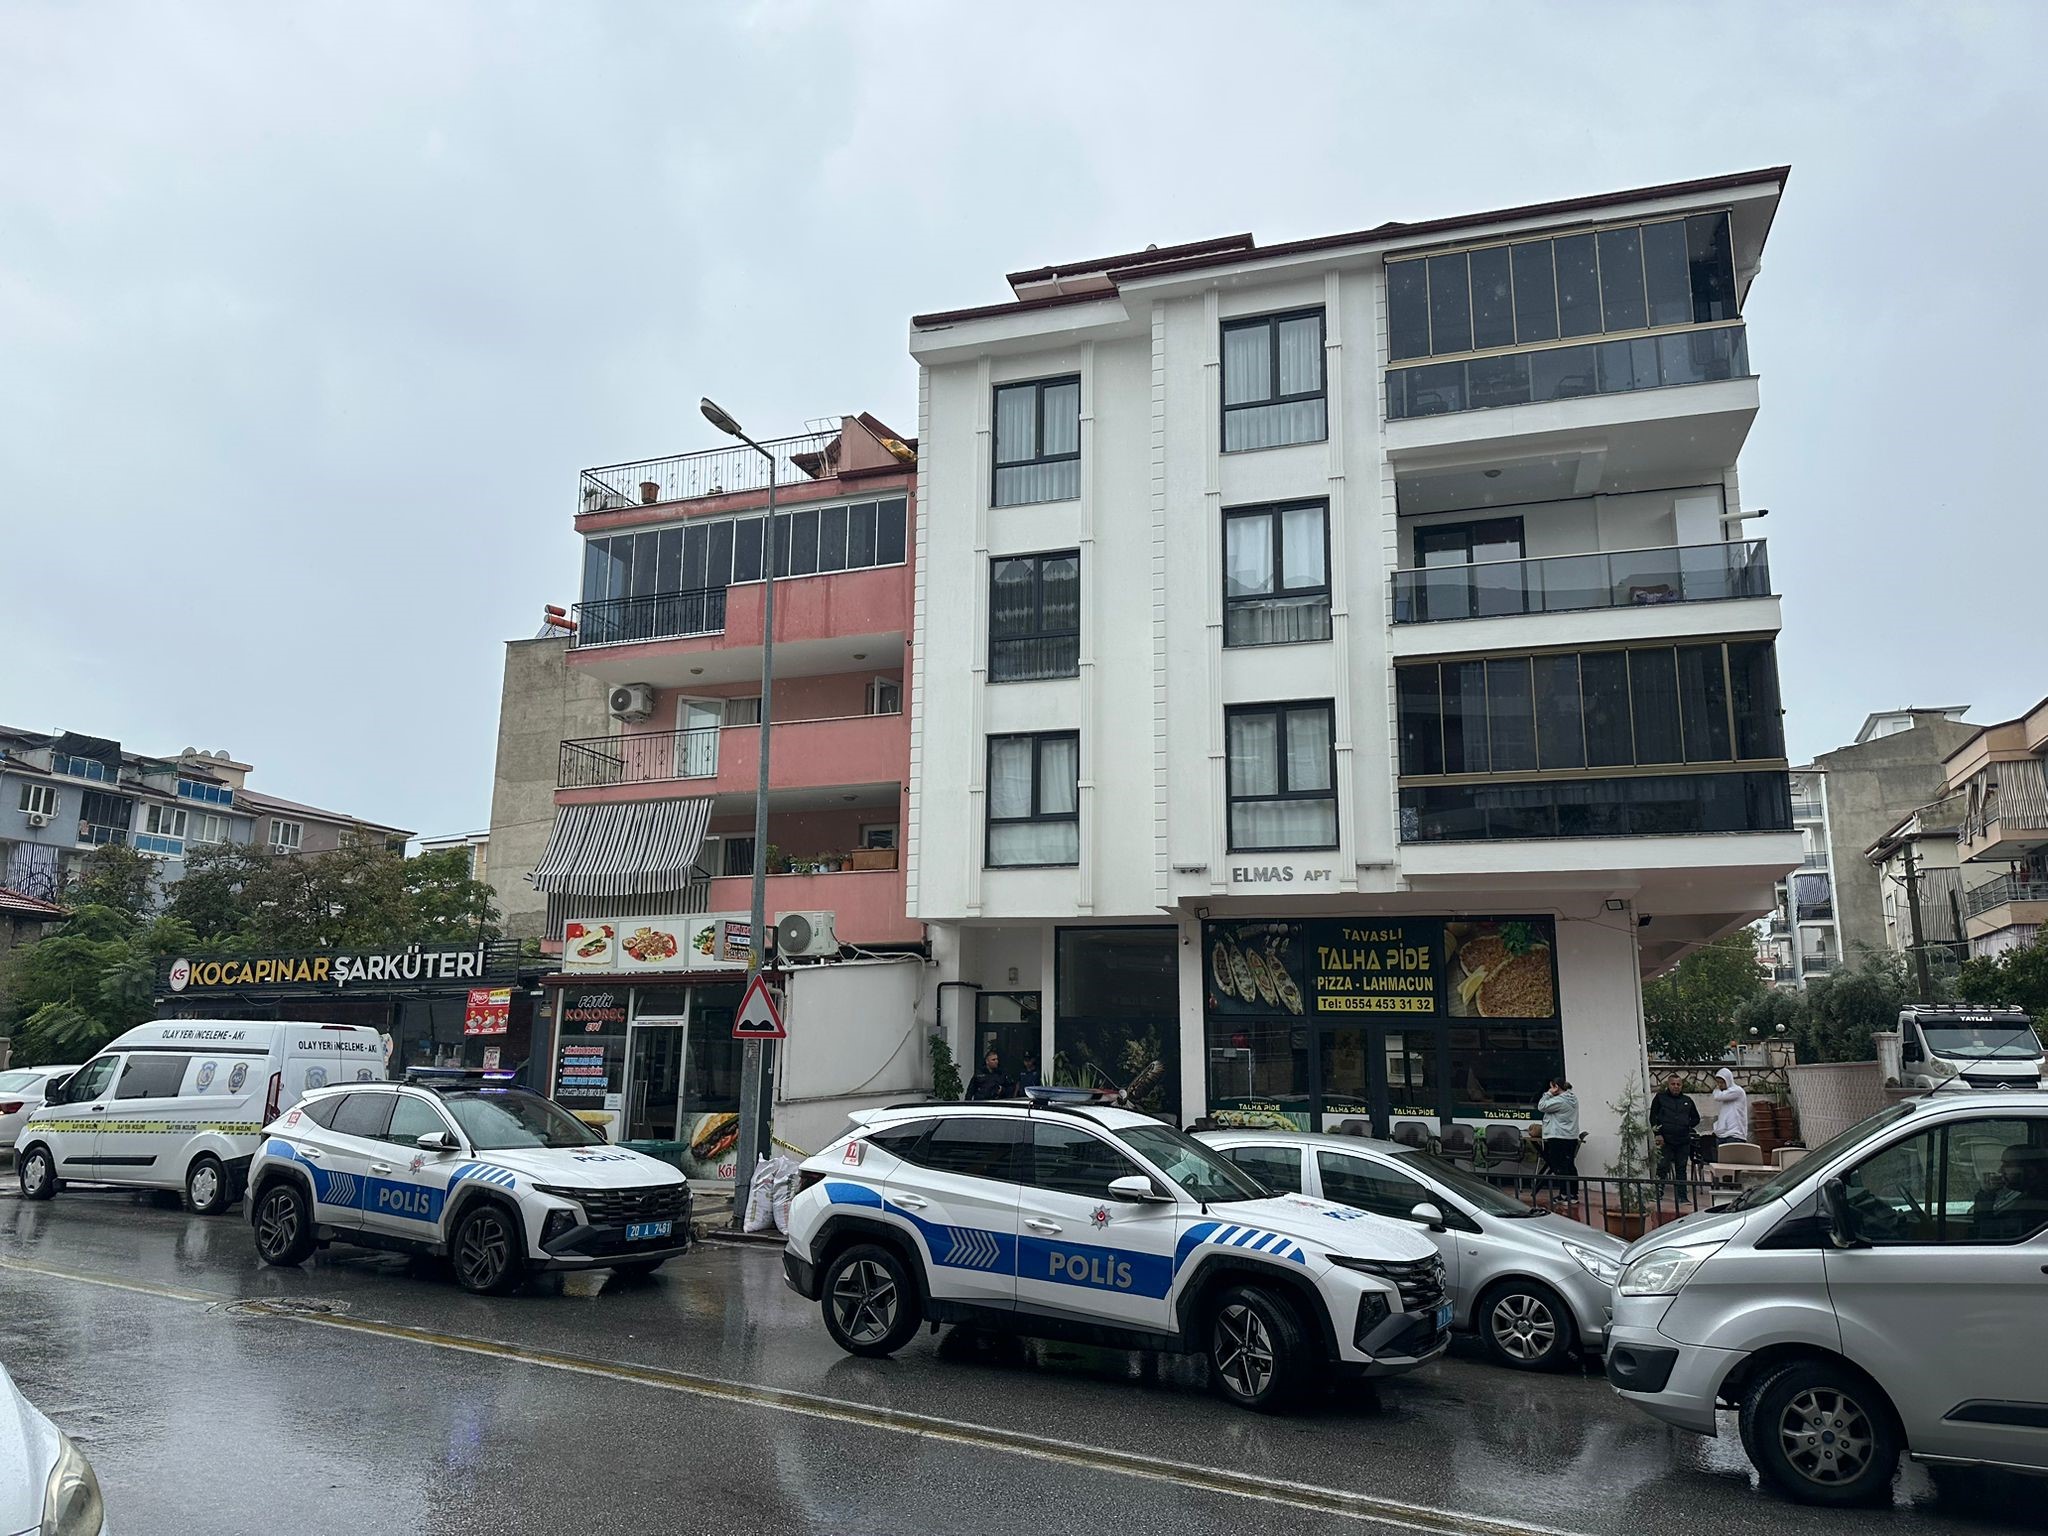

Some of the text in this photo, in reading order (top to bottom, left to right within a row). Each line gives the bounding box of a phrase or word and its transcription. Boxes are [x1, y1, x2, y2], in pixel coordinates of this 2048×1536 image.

[1232, 866, 1332, 883] ELMAS APT
[1342, 927, 1402, 942] TAVASLI
[1317, 942, 1430, 970] TALHA PİDE
[189, 957, 331, 986] KOCAPINAR
[333, 942, 484, 987] ŞARKÜTERİ
[1363, 976, 1433, 991] LAHMACUN
[578, 992, 614, 1008] FATİH
[1321, 998, 1430, 1010] Tel: 0554 453 31 32
[162, 1029, 180, 1039] OLAY
[298, 1040, 316, 1050] OLAY
[1326, 1105, 1349, 1113] TALHA
[1393, 1107, 1417, 1115] TALHA
[1484, 1110, 1511, 1119] TALHA
[717, 1163, 737, 1179] Köf
[378, 1186, 430, 1214] POLİS
[630, 1225, 640, 1237] 20
[644, 1224, 649, 1235] A
[1049, 1251, 1132, 1288] POLİS
